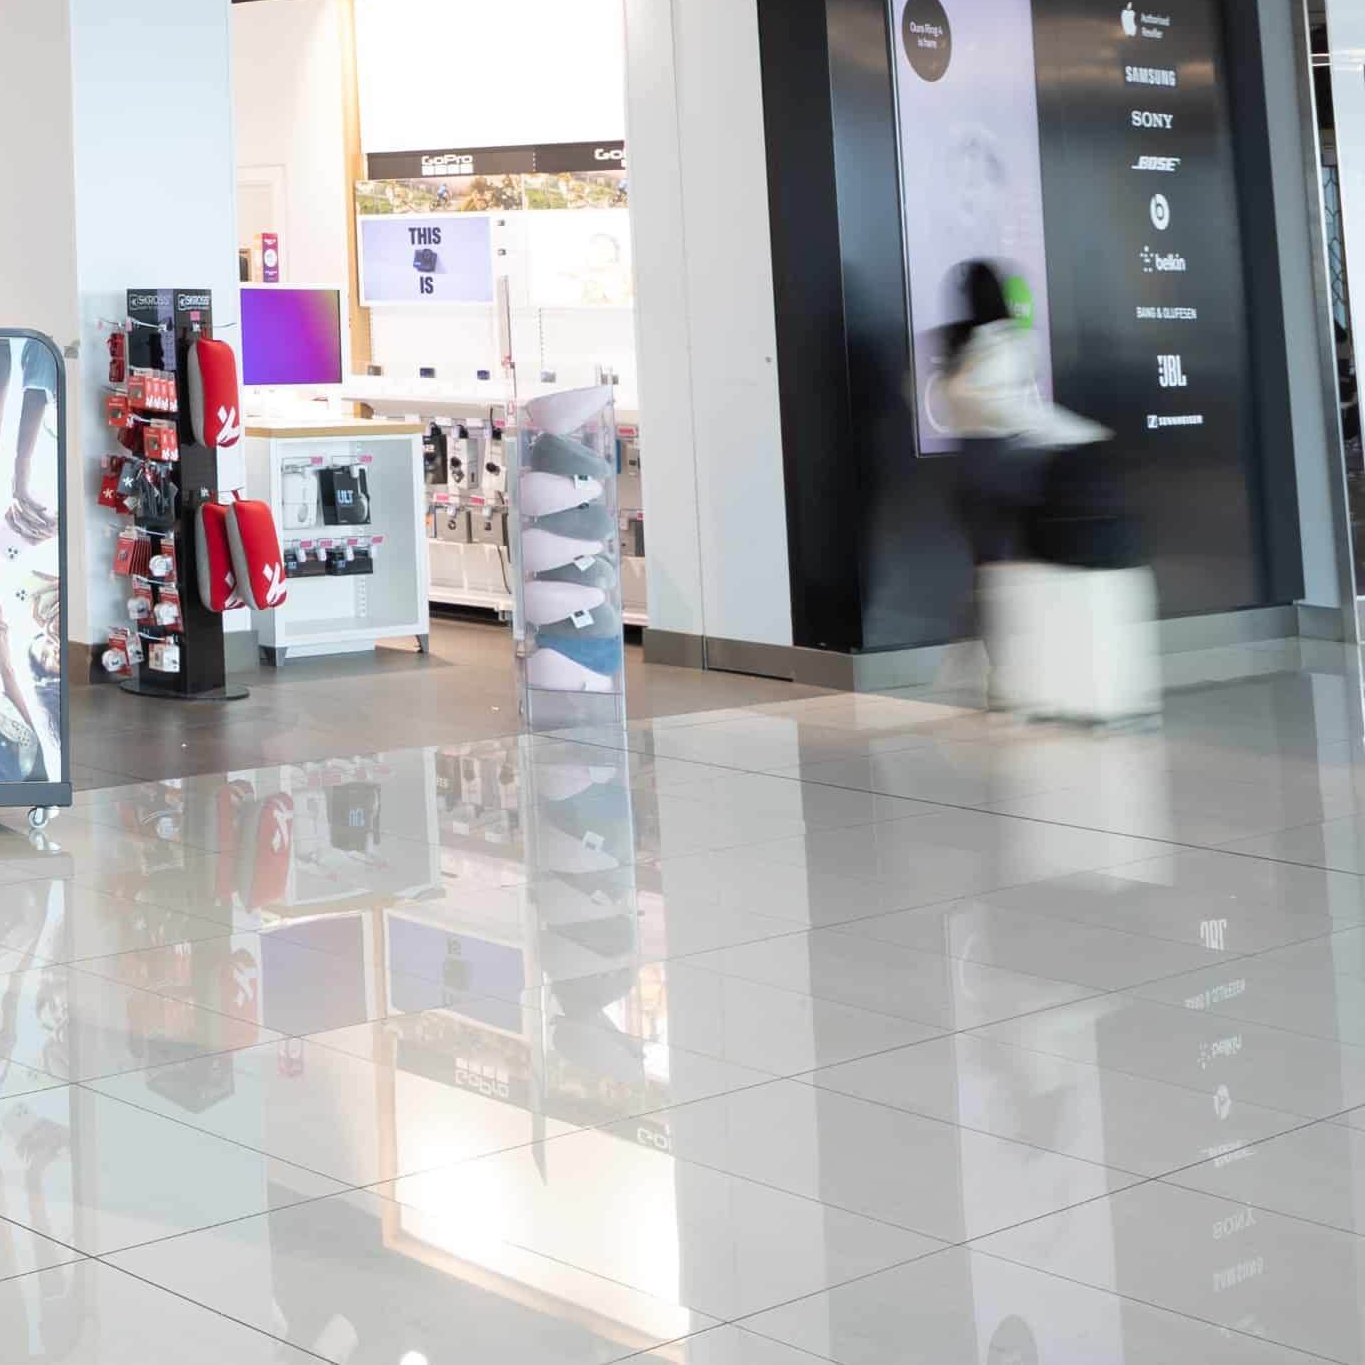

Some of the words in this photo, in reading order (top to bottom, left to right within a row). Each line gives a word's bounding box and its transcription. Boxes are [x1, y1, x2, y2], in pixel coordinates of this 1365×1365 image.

[1125, 66, 1176, 87] SAMSUNG
[1131, 111, 1174, 129] SONY
[421, 154, 473, 166] GoPro
[594, 148, 626, 160] Go
[1131, 156, 1181, 172] BOSE
[408, 227, 442, 245] THIS
[1155, 254, 1186, 271] belkin
[420, 277, 434, 294] IS
[185, 295, 210, 306] SKROSS
[1157, 354, 1187, 387] JBL
[337, 490, 354, 504] ULT
